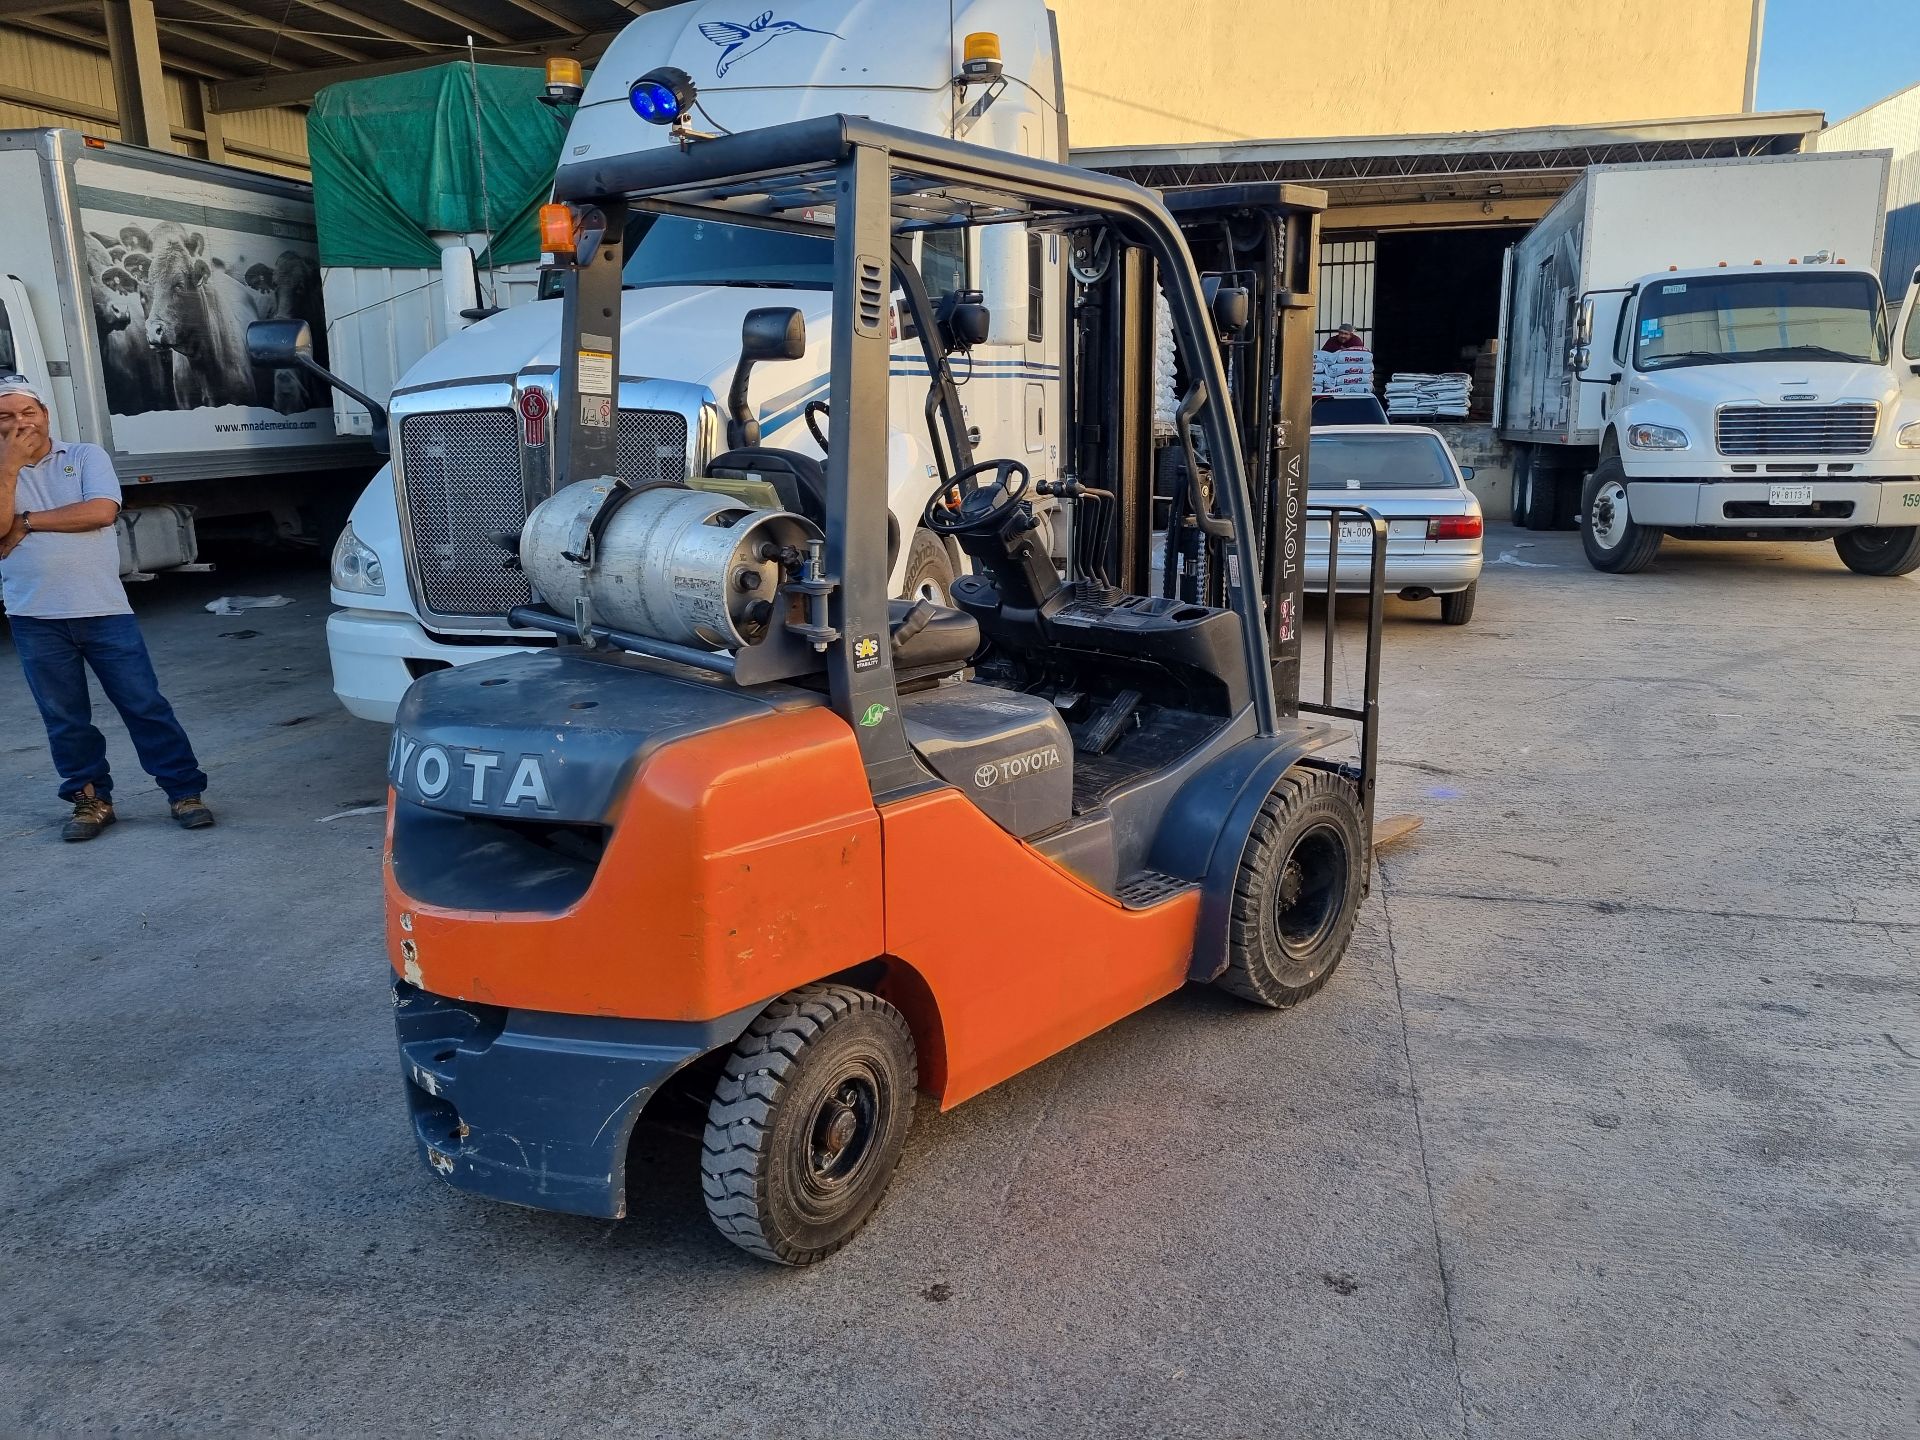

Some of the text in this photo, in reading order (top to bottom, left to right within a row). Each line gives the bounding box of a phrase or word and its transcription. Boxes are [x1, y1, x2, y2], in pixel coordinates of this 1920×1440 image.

[214, 420, 317, 433] www.mnademexico.com
[1283, 454, 1301, 579] TOYOTA
[855, 638, 879, 659] SAS
[1000, 748, 1061, 780] TOYOTA
